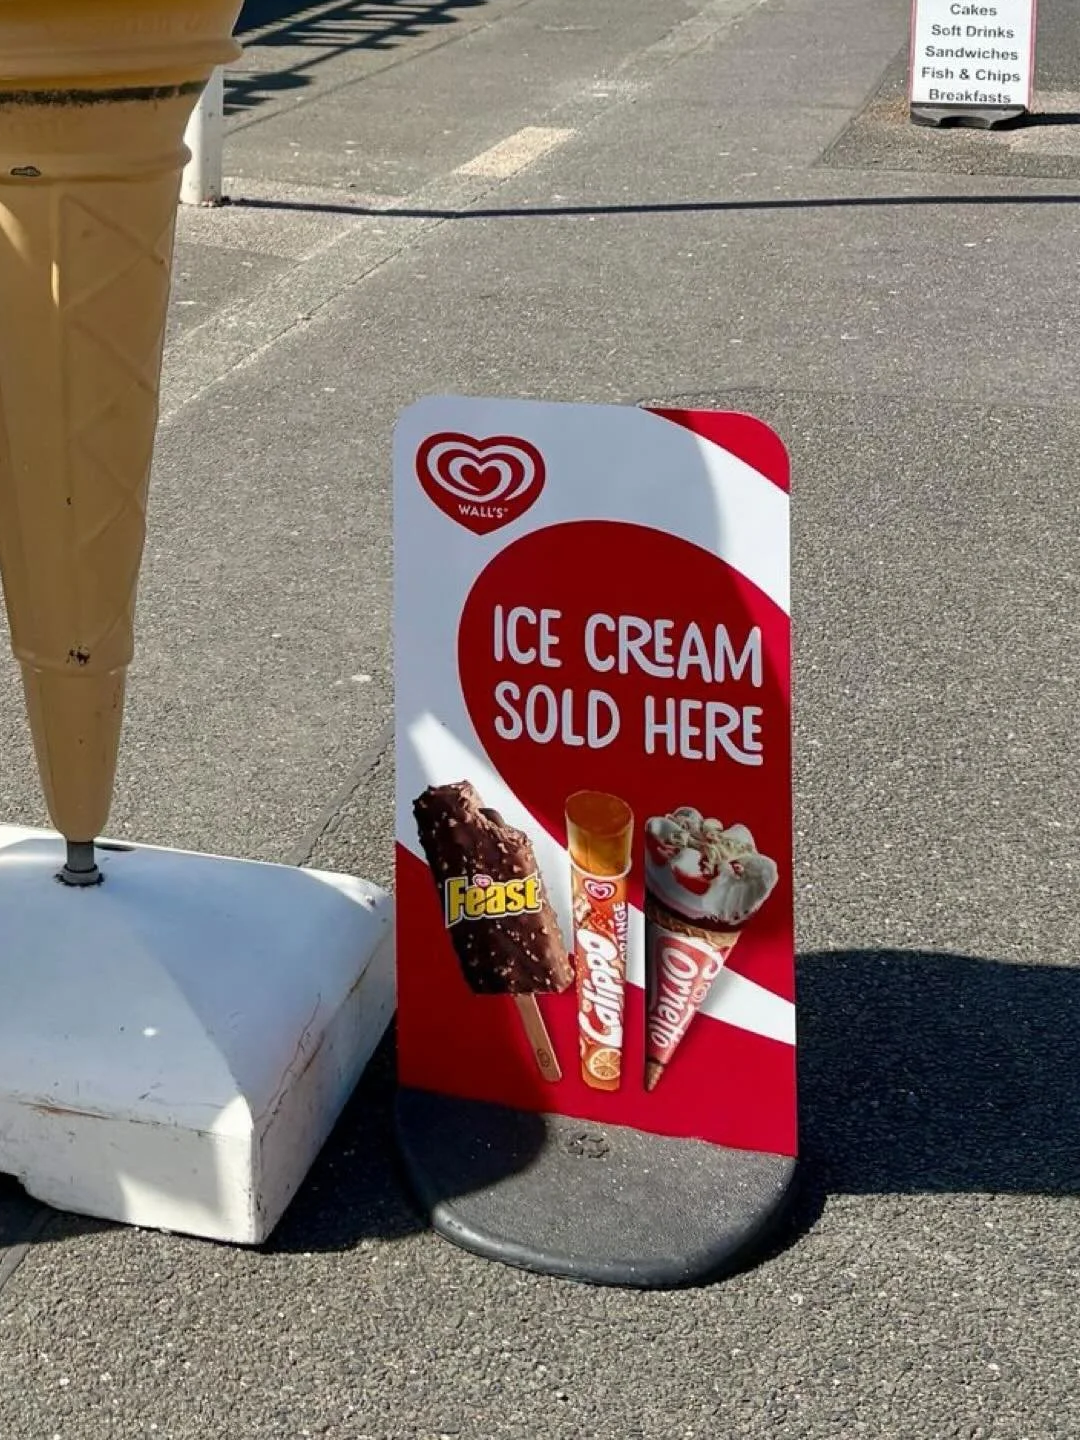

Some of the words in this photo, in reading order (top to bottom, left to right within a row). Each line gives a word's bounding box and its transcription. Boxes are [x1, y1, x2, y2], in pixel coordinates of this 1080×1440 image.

[950, 3, 997, 16] Cakes
[931, 24, 961, 37] Soft
[966, 25, 1014, 38] Drinks
[925, 45, 1018, 60] Sandwiches
[921, 66, 954, 79] Fish
[959, 68, 969, 80] &
[975, 68, 1021, 84] Chips
[929, 88, 1011, 103] Breakfasts
[458, 504, 504, 518] WALL'S
[494, 604, 562, 668] ICE
[584, 613, 762, 688] CREAM
[494, 680, 620, 749] SOLD
[644, 695, 764, 766] HERE
[446, 874, 541, 927] Feast
[576, 927, 623, 1049] Calippo
[651, 930, 724, 1048] Cornetto
